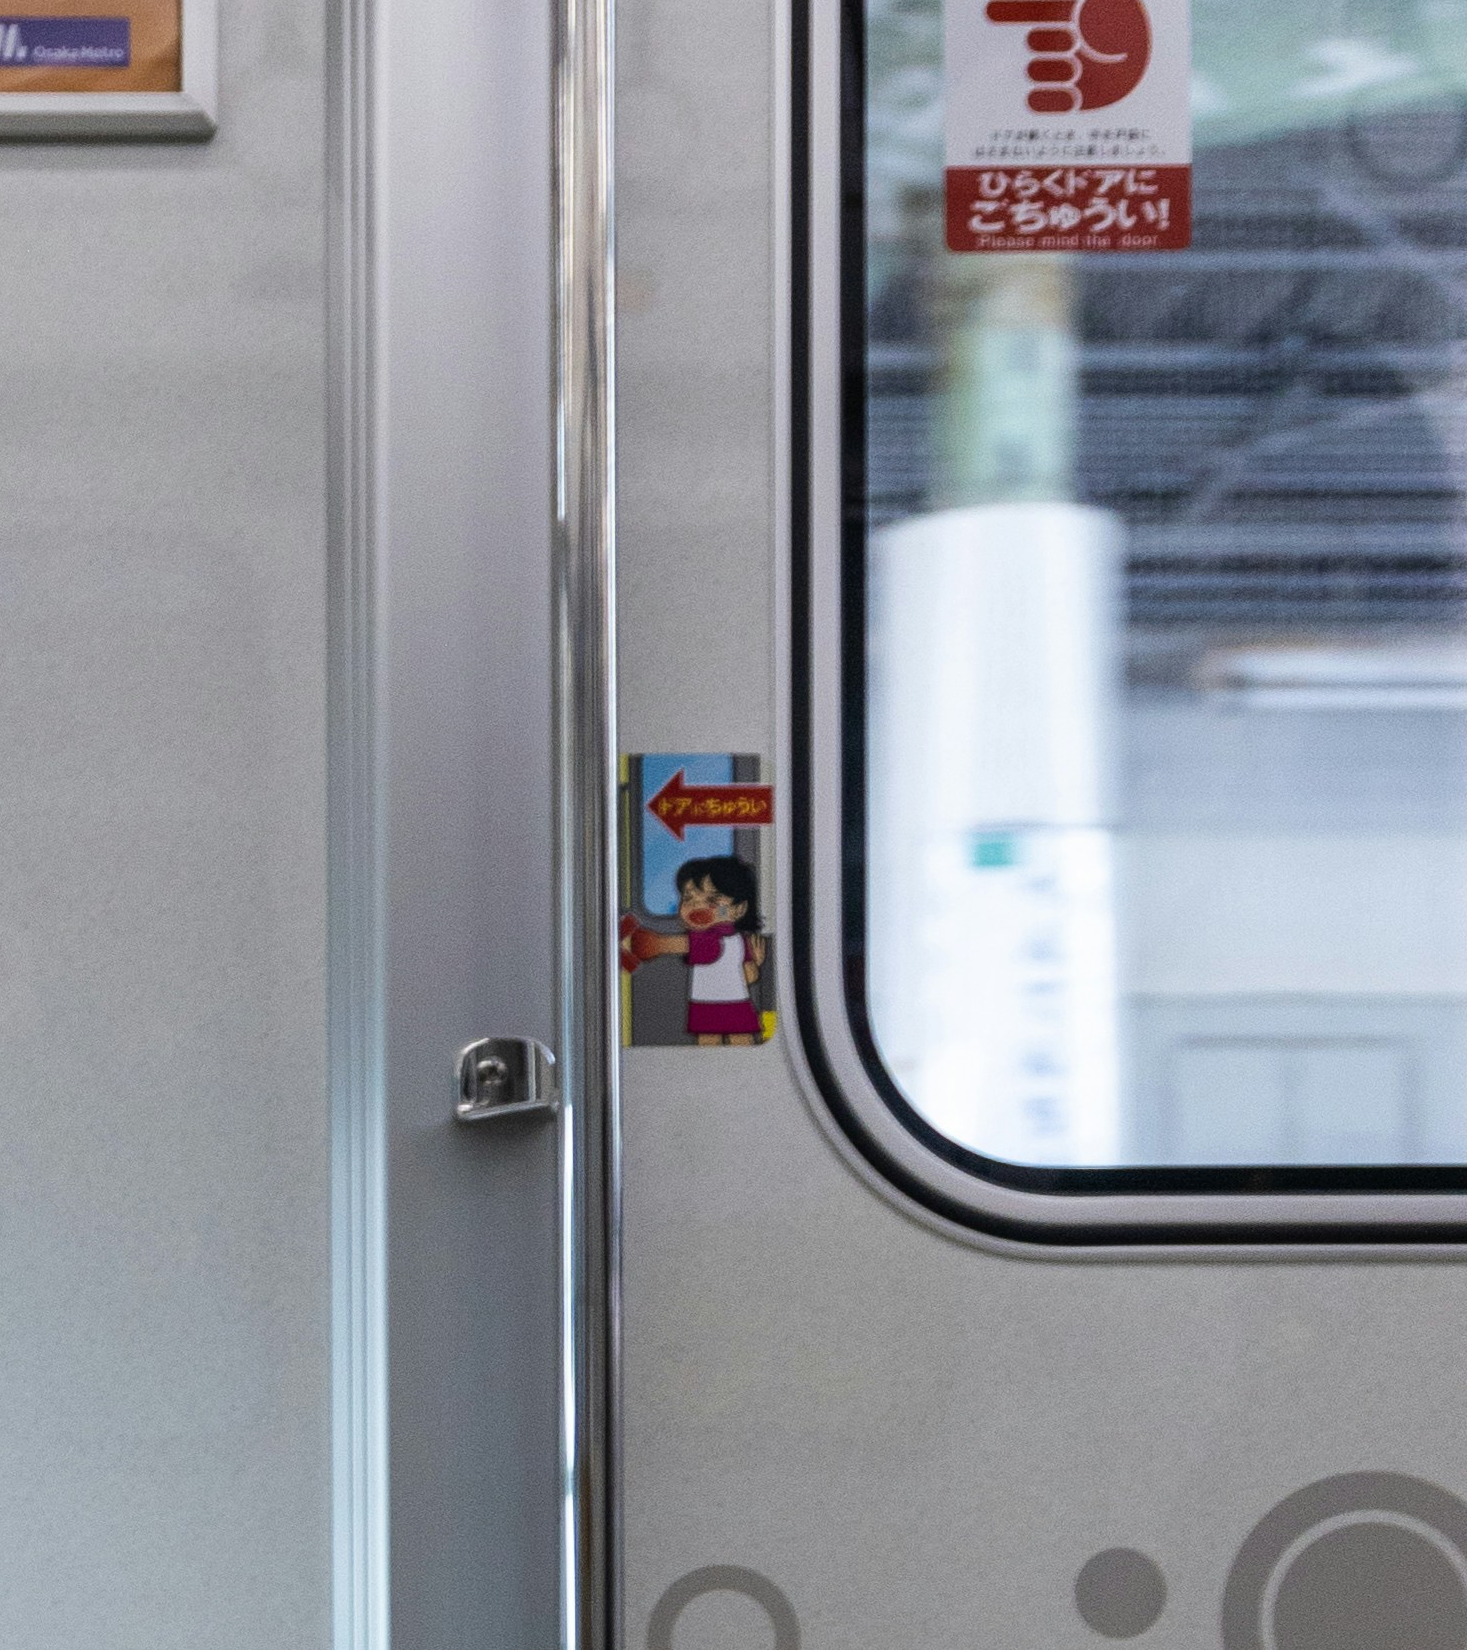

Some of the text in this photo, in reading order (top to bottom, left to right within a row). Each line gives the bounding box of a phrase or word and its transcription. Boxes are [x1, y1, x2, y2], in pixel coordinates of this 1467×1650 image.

[978, 168, 1160, 198] ひらくドアに
